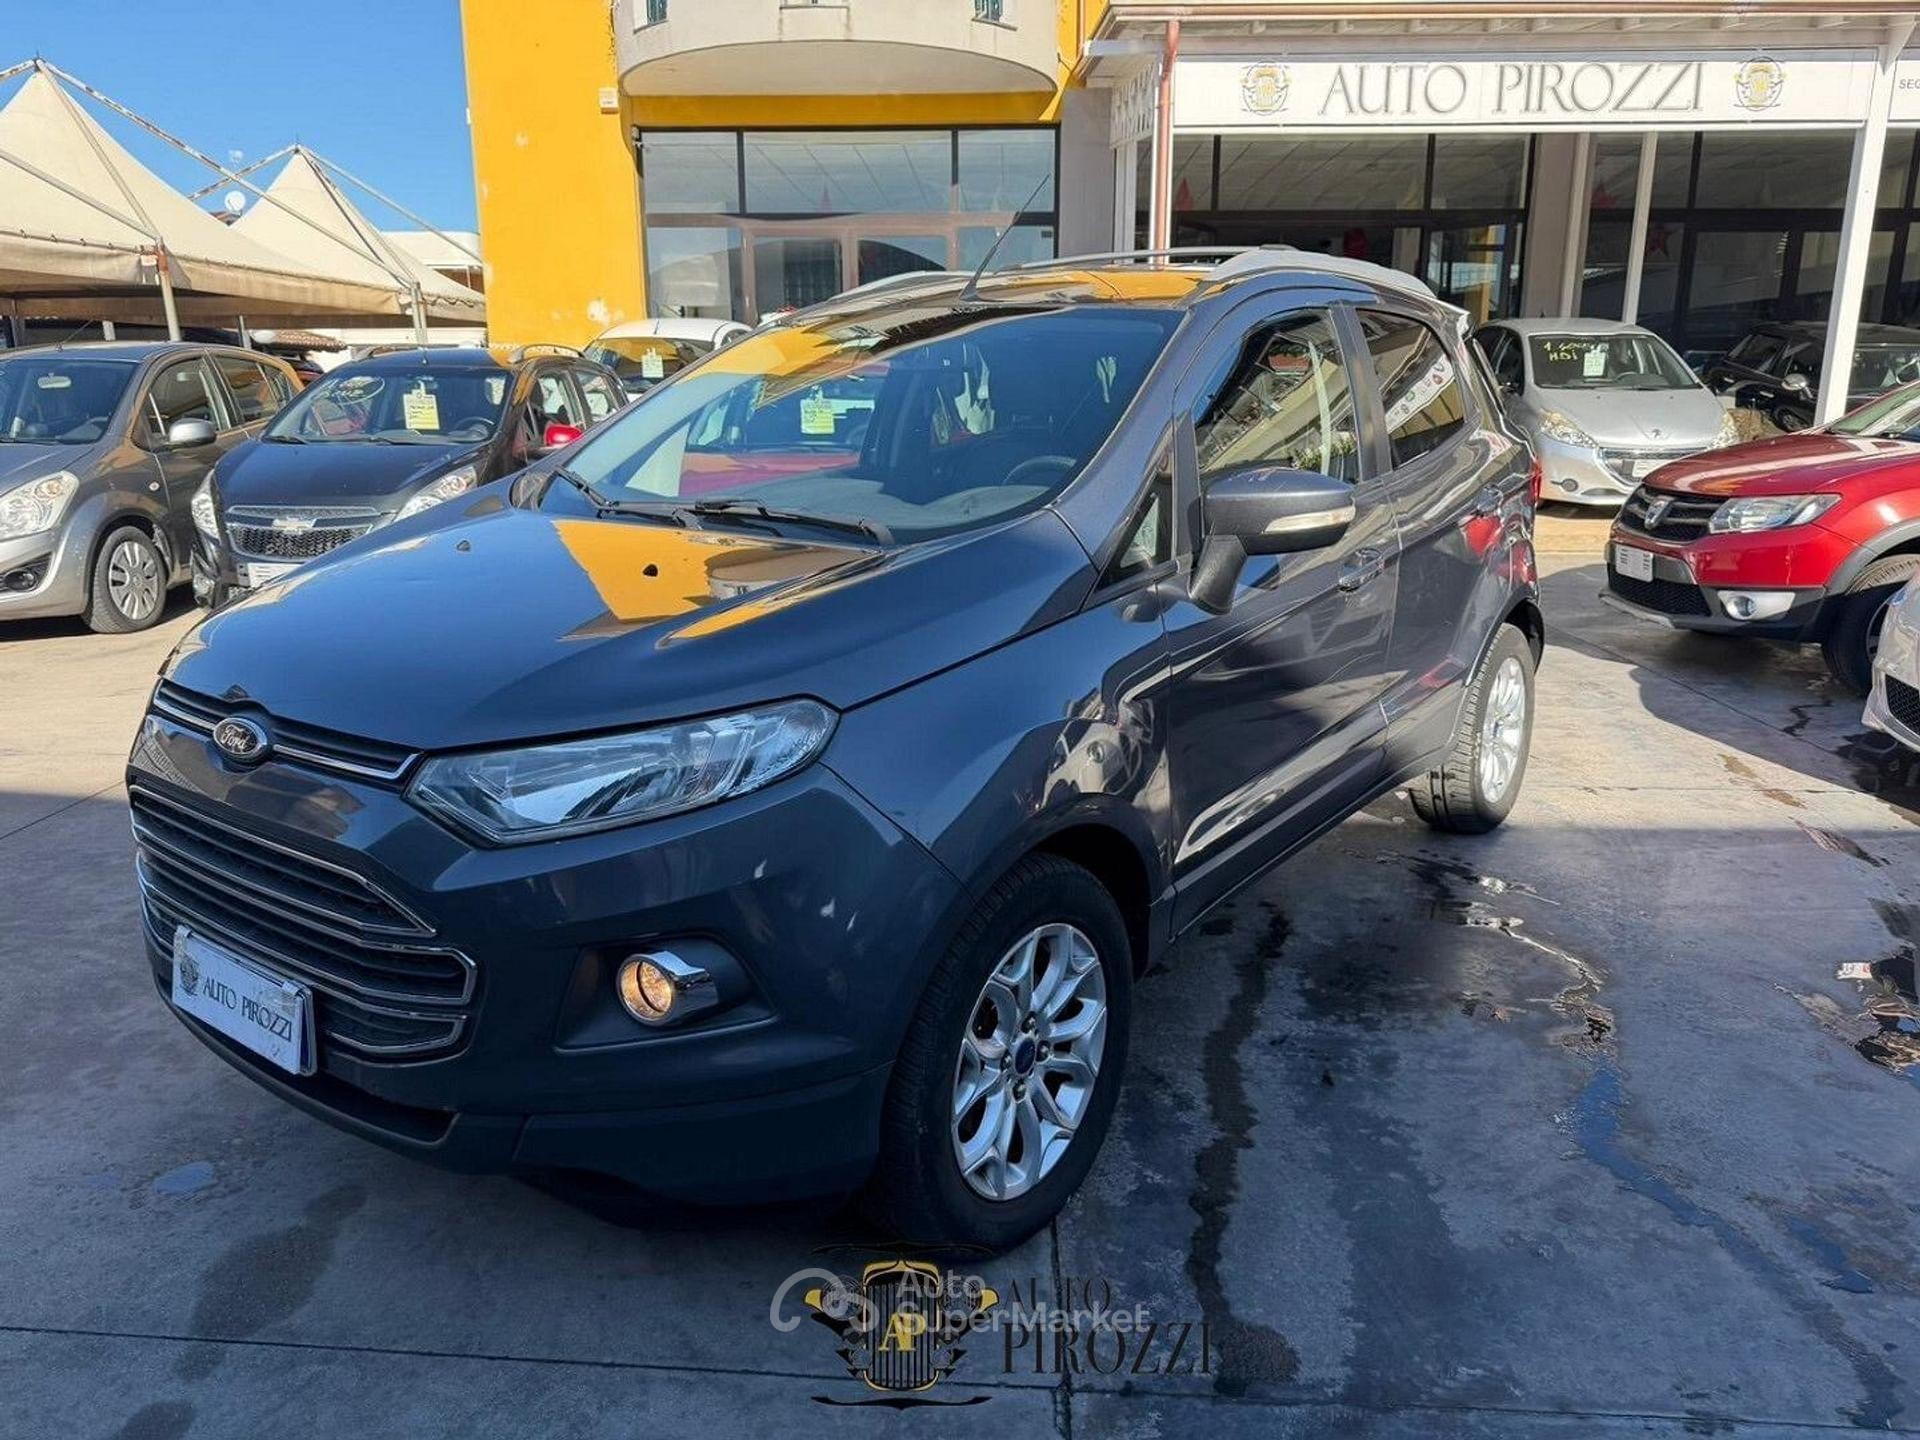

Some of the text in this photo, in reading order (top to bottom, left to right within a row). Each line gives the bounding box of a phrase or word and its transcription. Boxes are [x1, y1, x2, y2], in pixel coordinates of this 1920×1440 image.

[1319, 62, 1704, 115] AUTO PIROZZI
[203, 976, 292, 1042] AUTO PIROZZI
